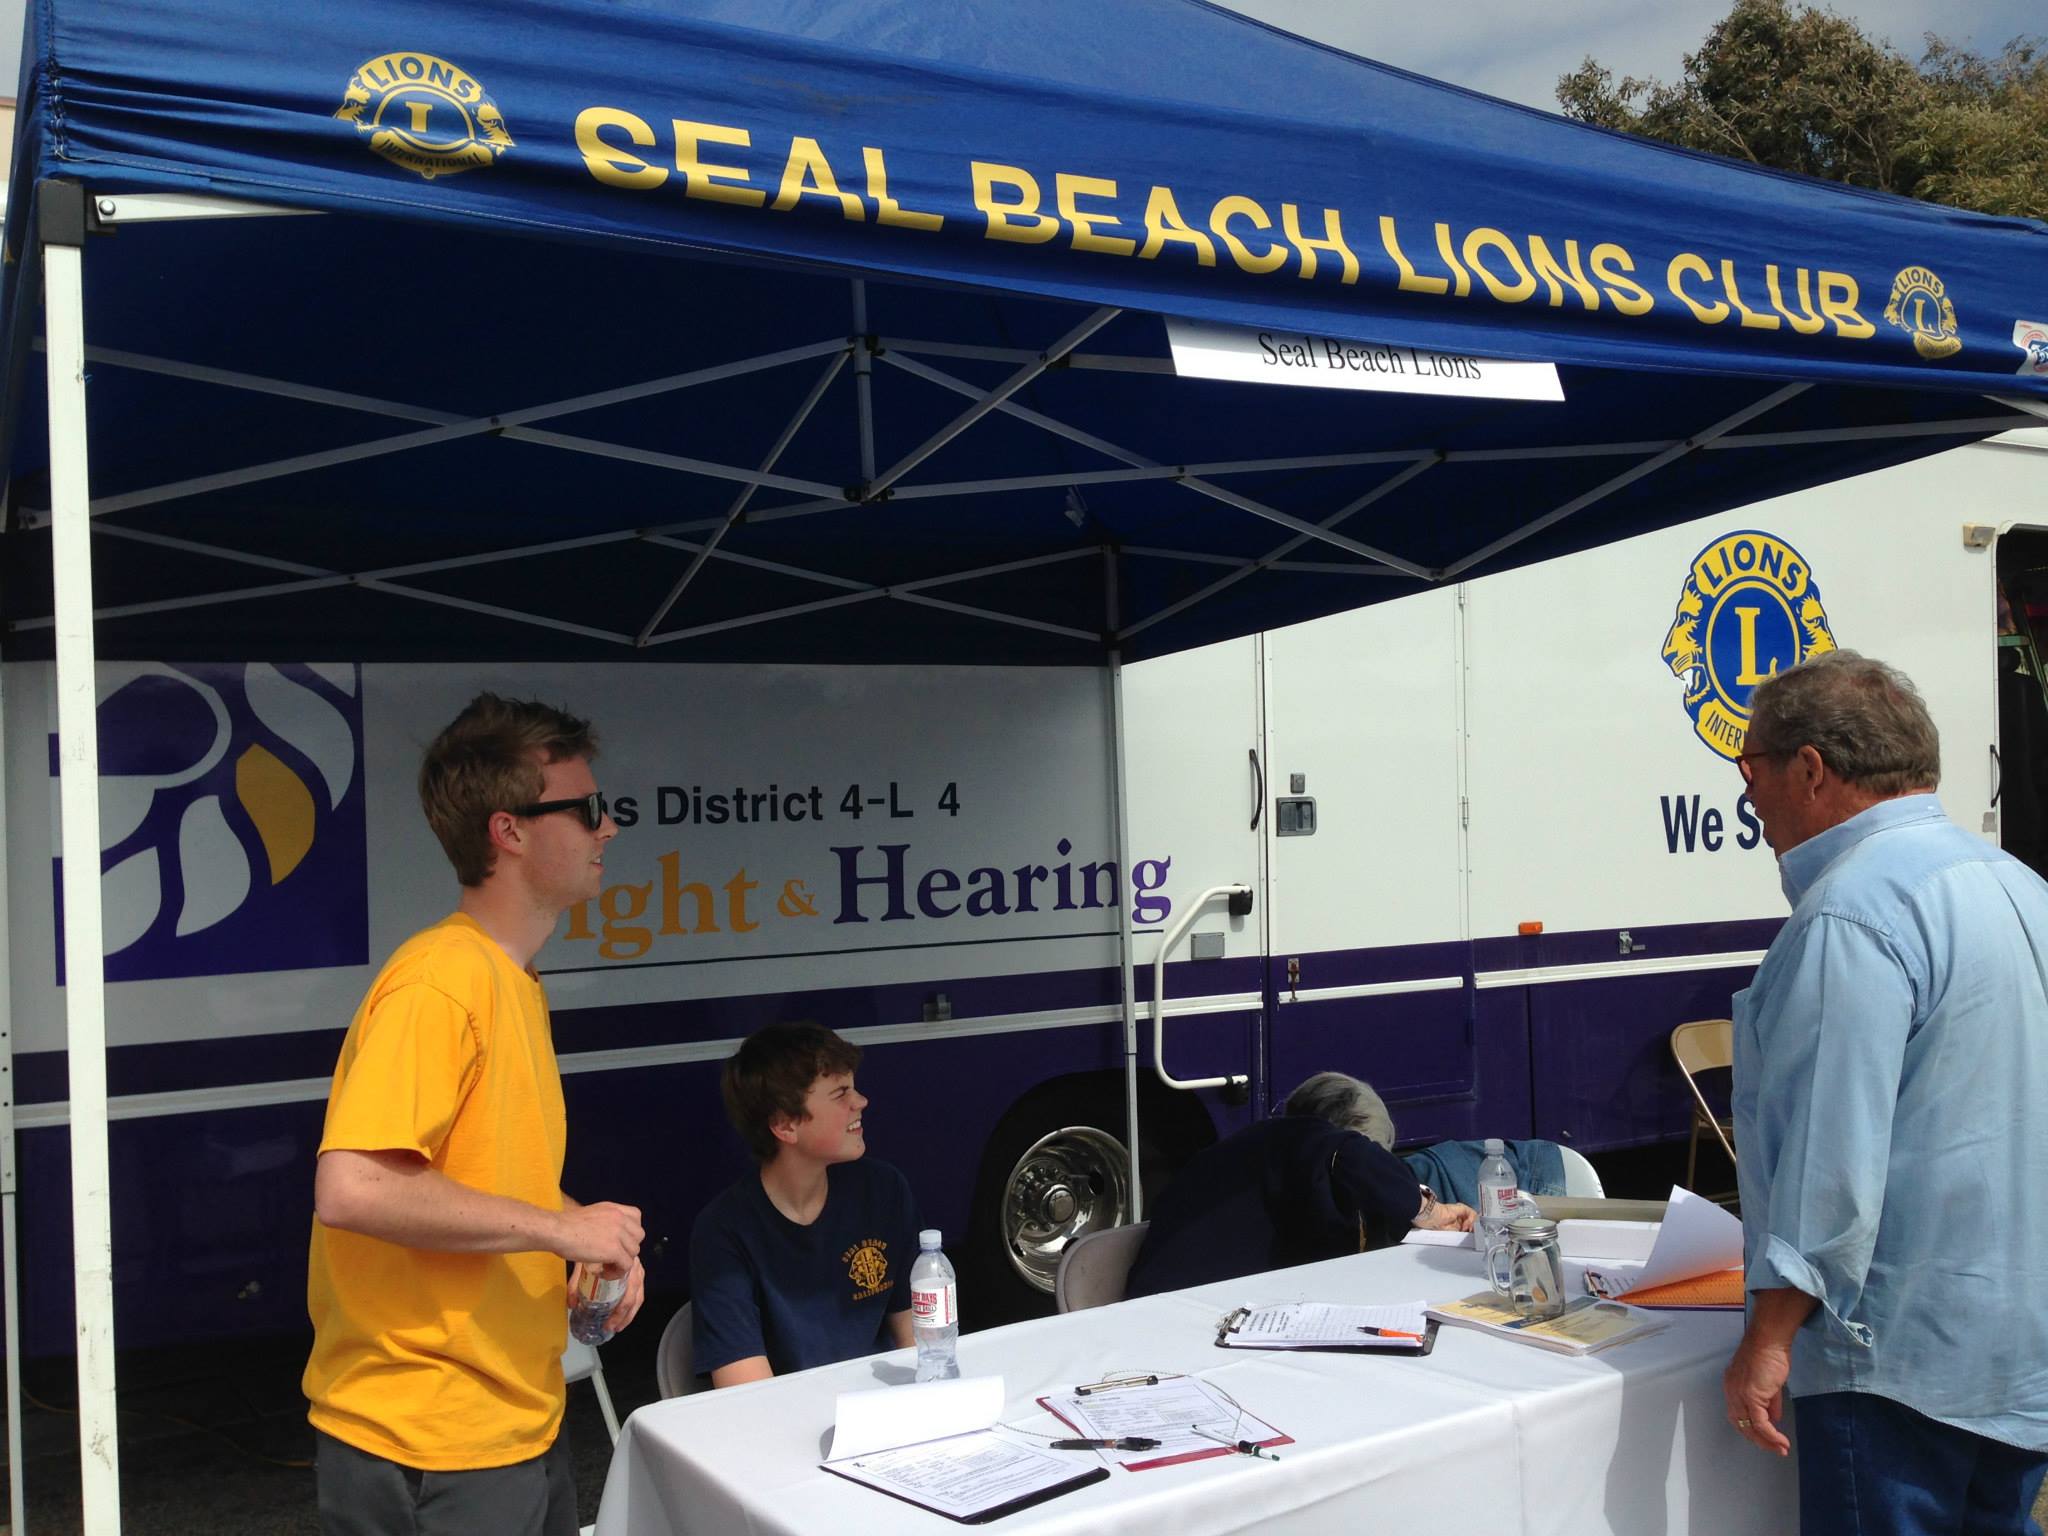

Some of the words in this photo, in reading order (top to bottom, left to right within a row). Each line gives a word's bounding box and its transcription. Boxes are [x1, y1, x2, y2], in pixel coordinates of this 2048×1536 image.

[366, 56, 475, 98] LIONS
[573, 105, 945, 233] SEAL
[970, 160, 1360, 285] BEACH
[1379, 215, 1655, 316] LIONS
[1667, 252, 1876, 340] CLUB
[1897, 268, 1942, 295] LIONS
[1913, 298, 1937, 334] L
[1258, 332, 1319, 369] Seal
[1323, 337, 1406, 375] Beach
[1410, 347, 1482, 381] Lions
[1701, 539, 1802, 592] LIONS
[1734, 606, 1777, 686] L
[656, 783, 824, 825] District
[839, 781, 914, 820] 4-L
[937, 781, 961, 817] 4
[1660, 793, 1724, 854] We
[776, 878, 820, 918] &
[829, 837, 1172, 924] Hearing
